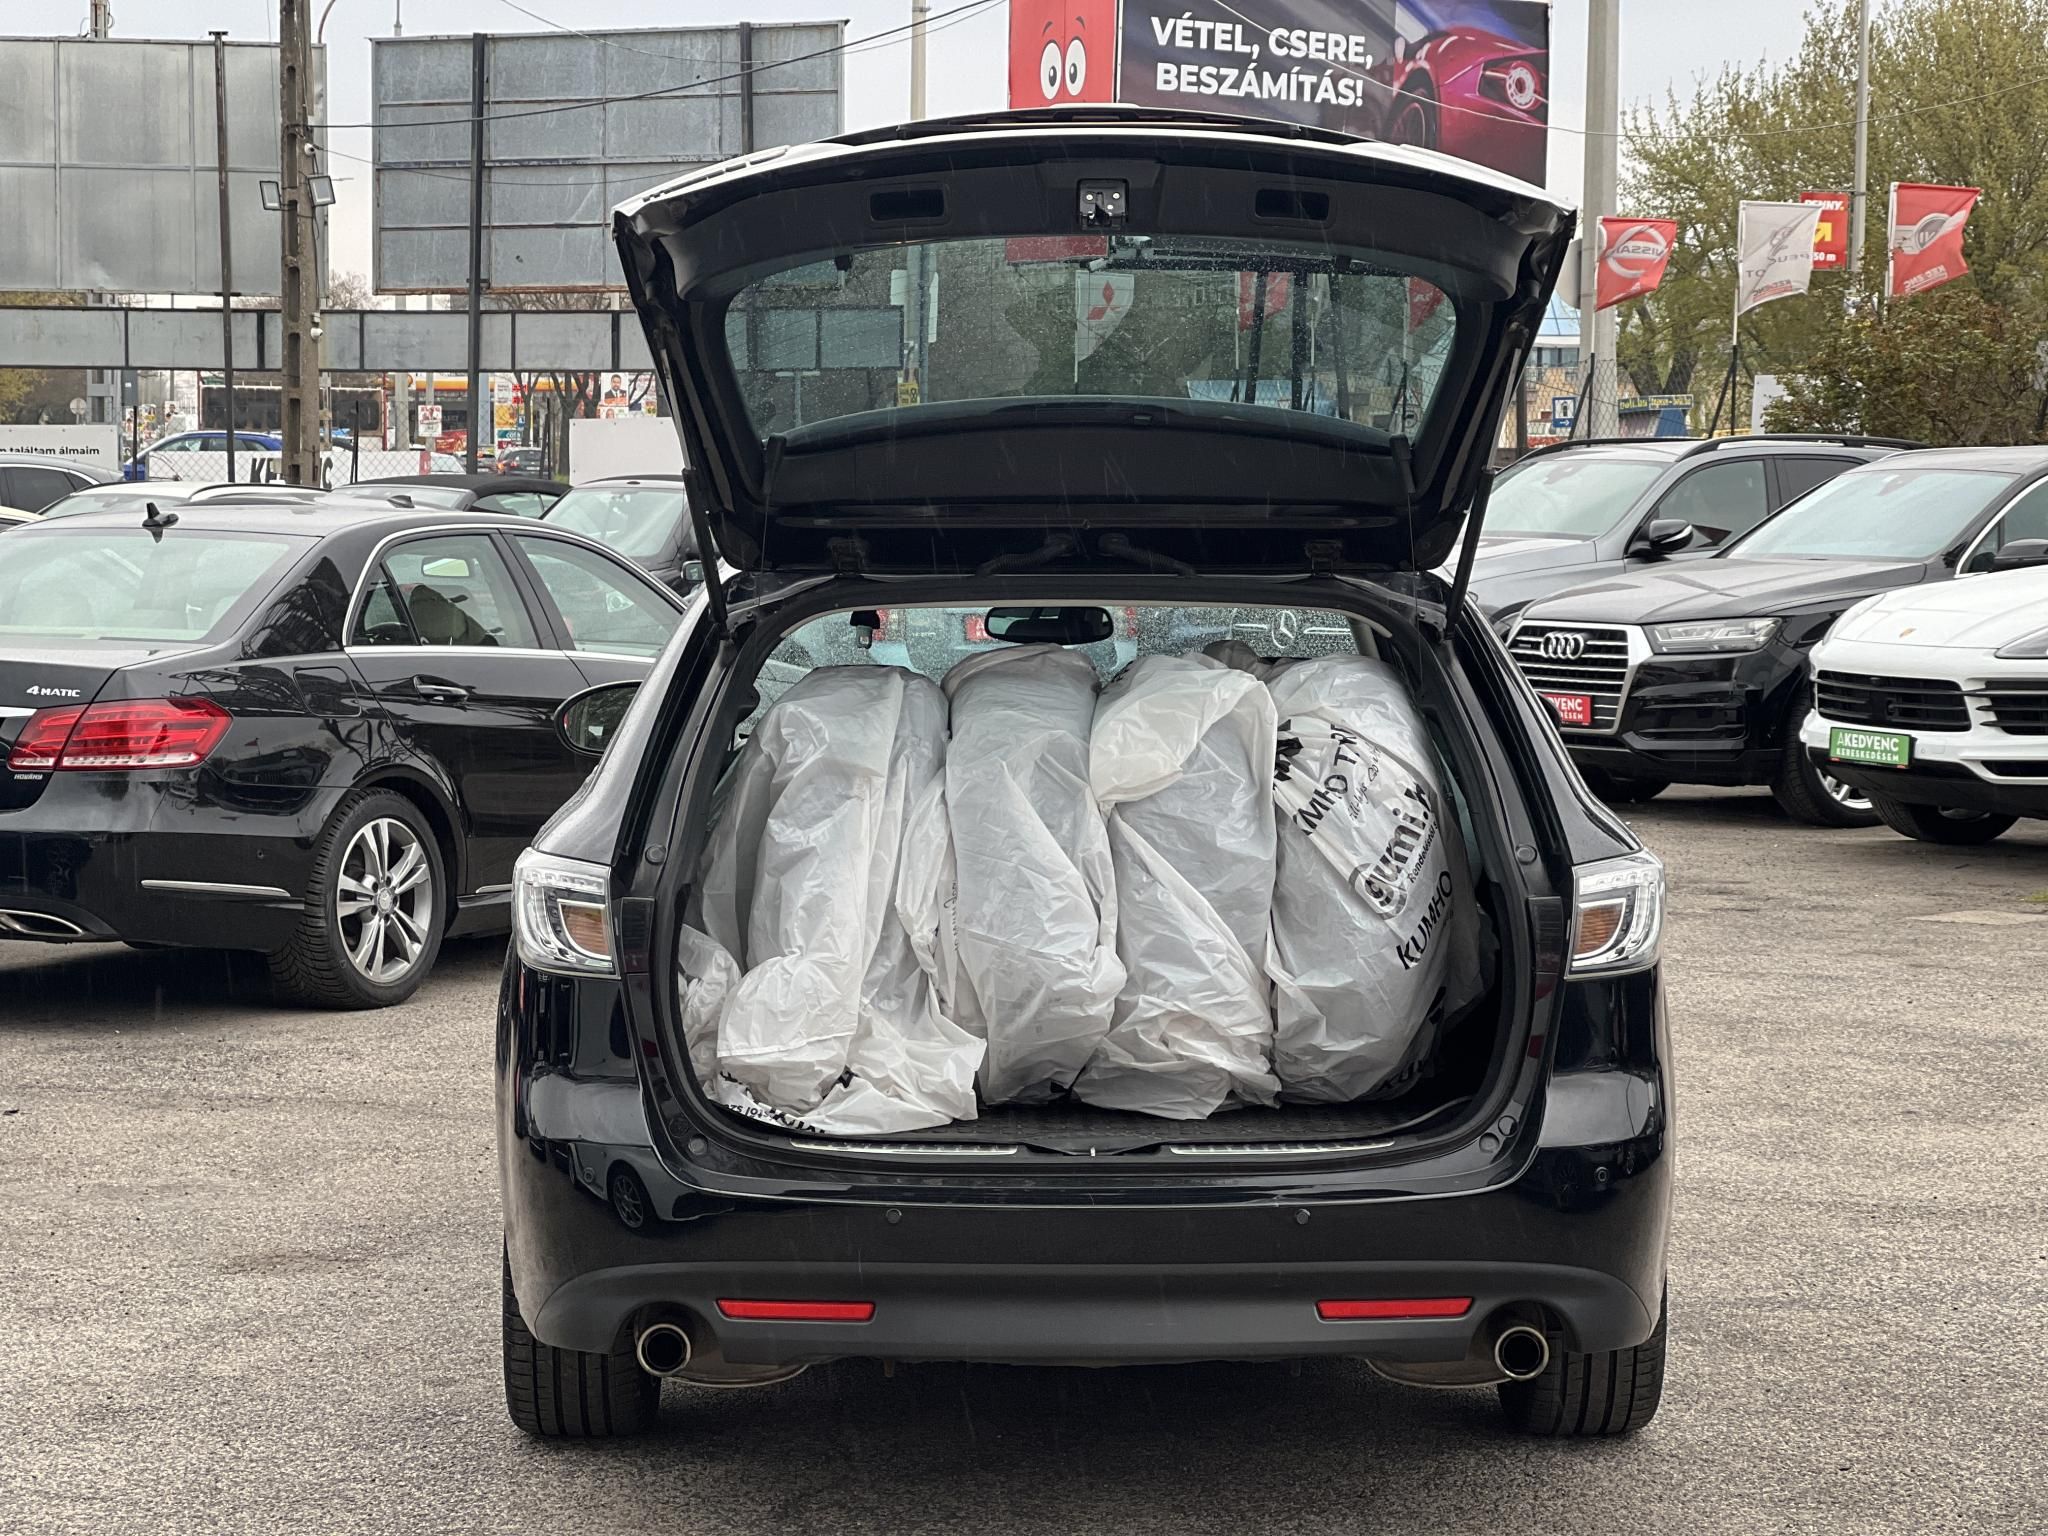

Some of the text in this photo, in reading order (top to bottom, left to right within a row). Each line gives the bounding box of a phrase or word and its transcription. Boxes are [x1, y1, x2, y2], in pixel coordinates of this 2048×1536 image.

[1151, 12, 1374, 70] VÉTEL, CSERE,
[1156, 62, 1364, 107] BESZÁMÍTÁS!
[59, 446, 100, 455] álmaim
[26, 685, 81, 697] 4MATIC
[1395, 870, 1452, 970] KUMHO
